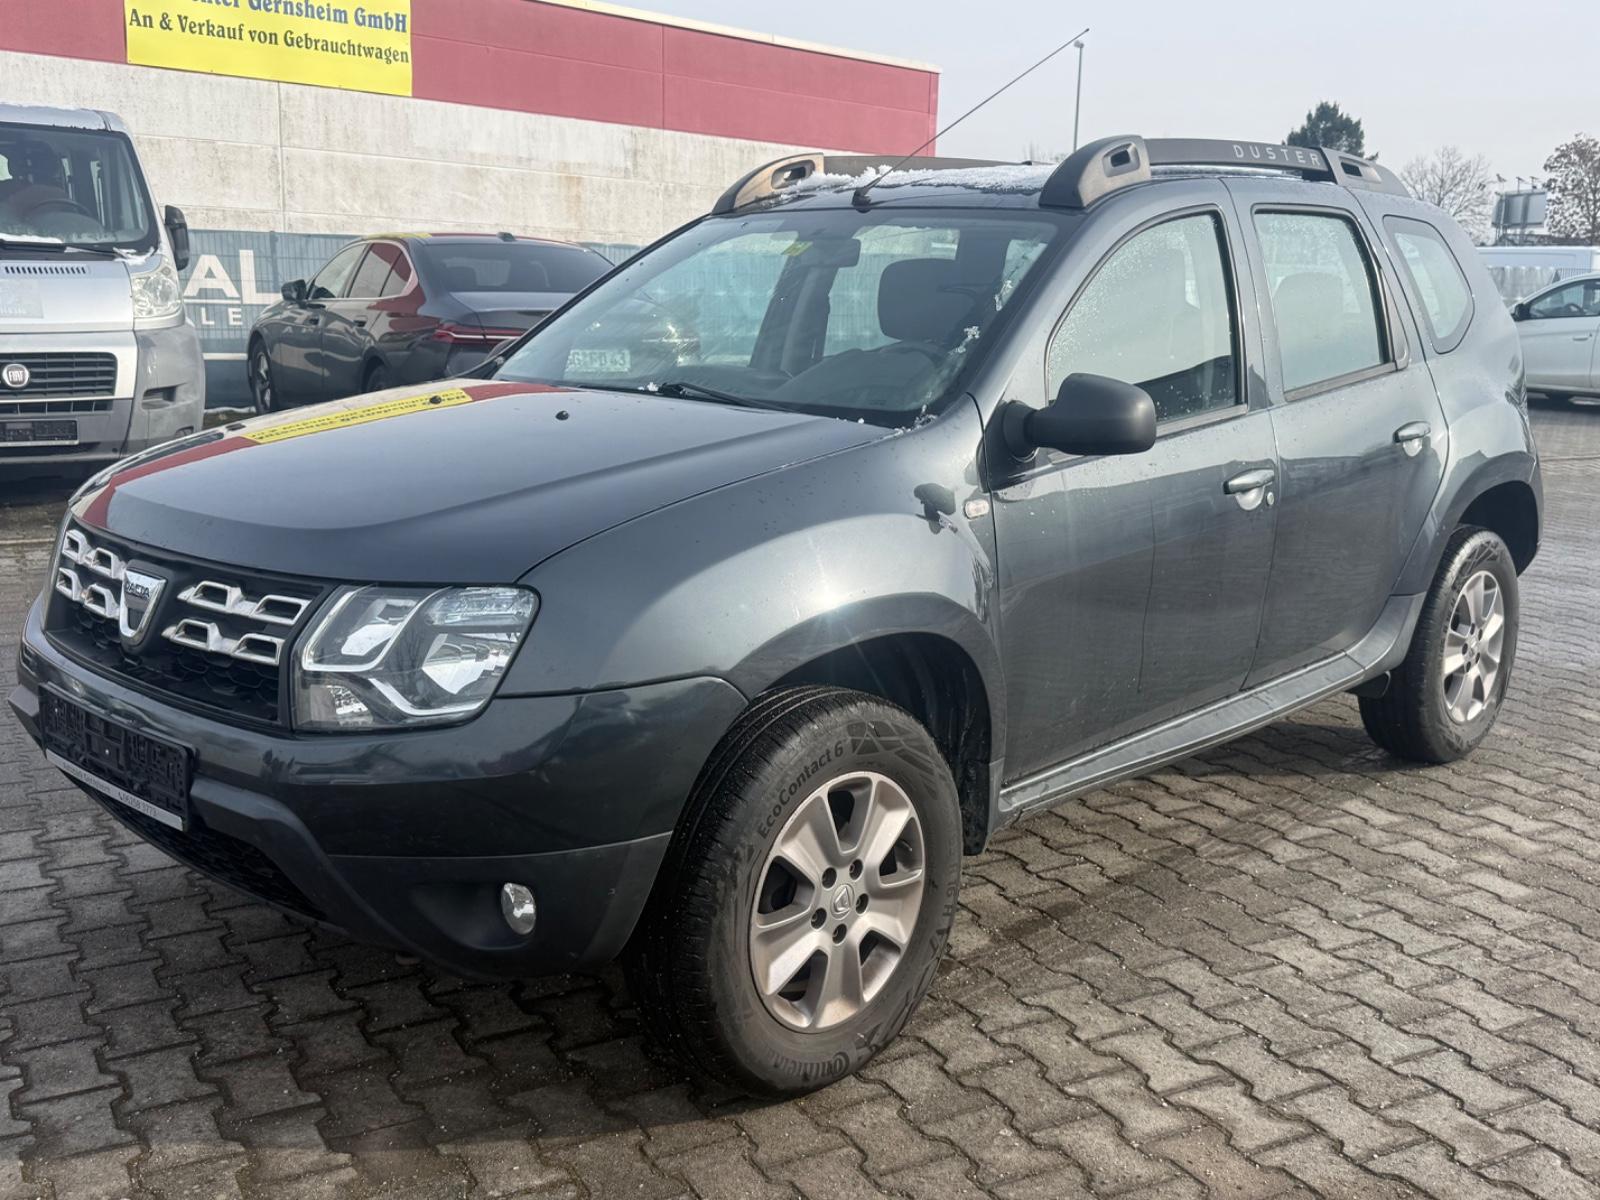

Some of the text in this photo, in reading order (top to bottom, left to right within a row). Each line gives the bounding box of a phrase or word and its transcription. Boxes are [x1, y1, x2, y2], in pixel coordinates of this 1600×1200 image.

[129, 8, 409, 65] An & Verkauf von Gebrauchtwagen
[248, 0, 407, 33] Gernsheim GmbH
[1233, 144, 1321, 166] DUSTER
[757, 740, 844, 839] EcoContact 6
